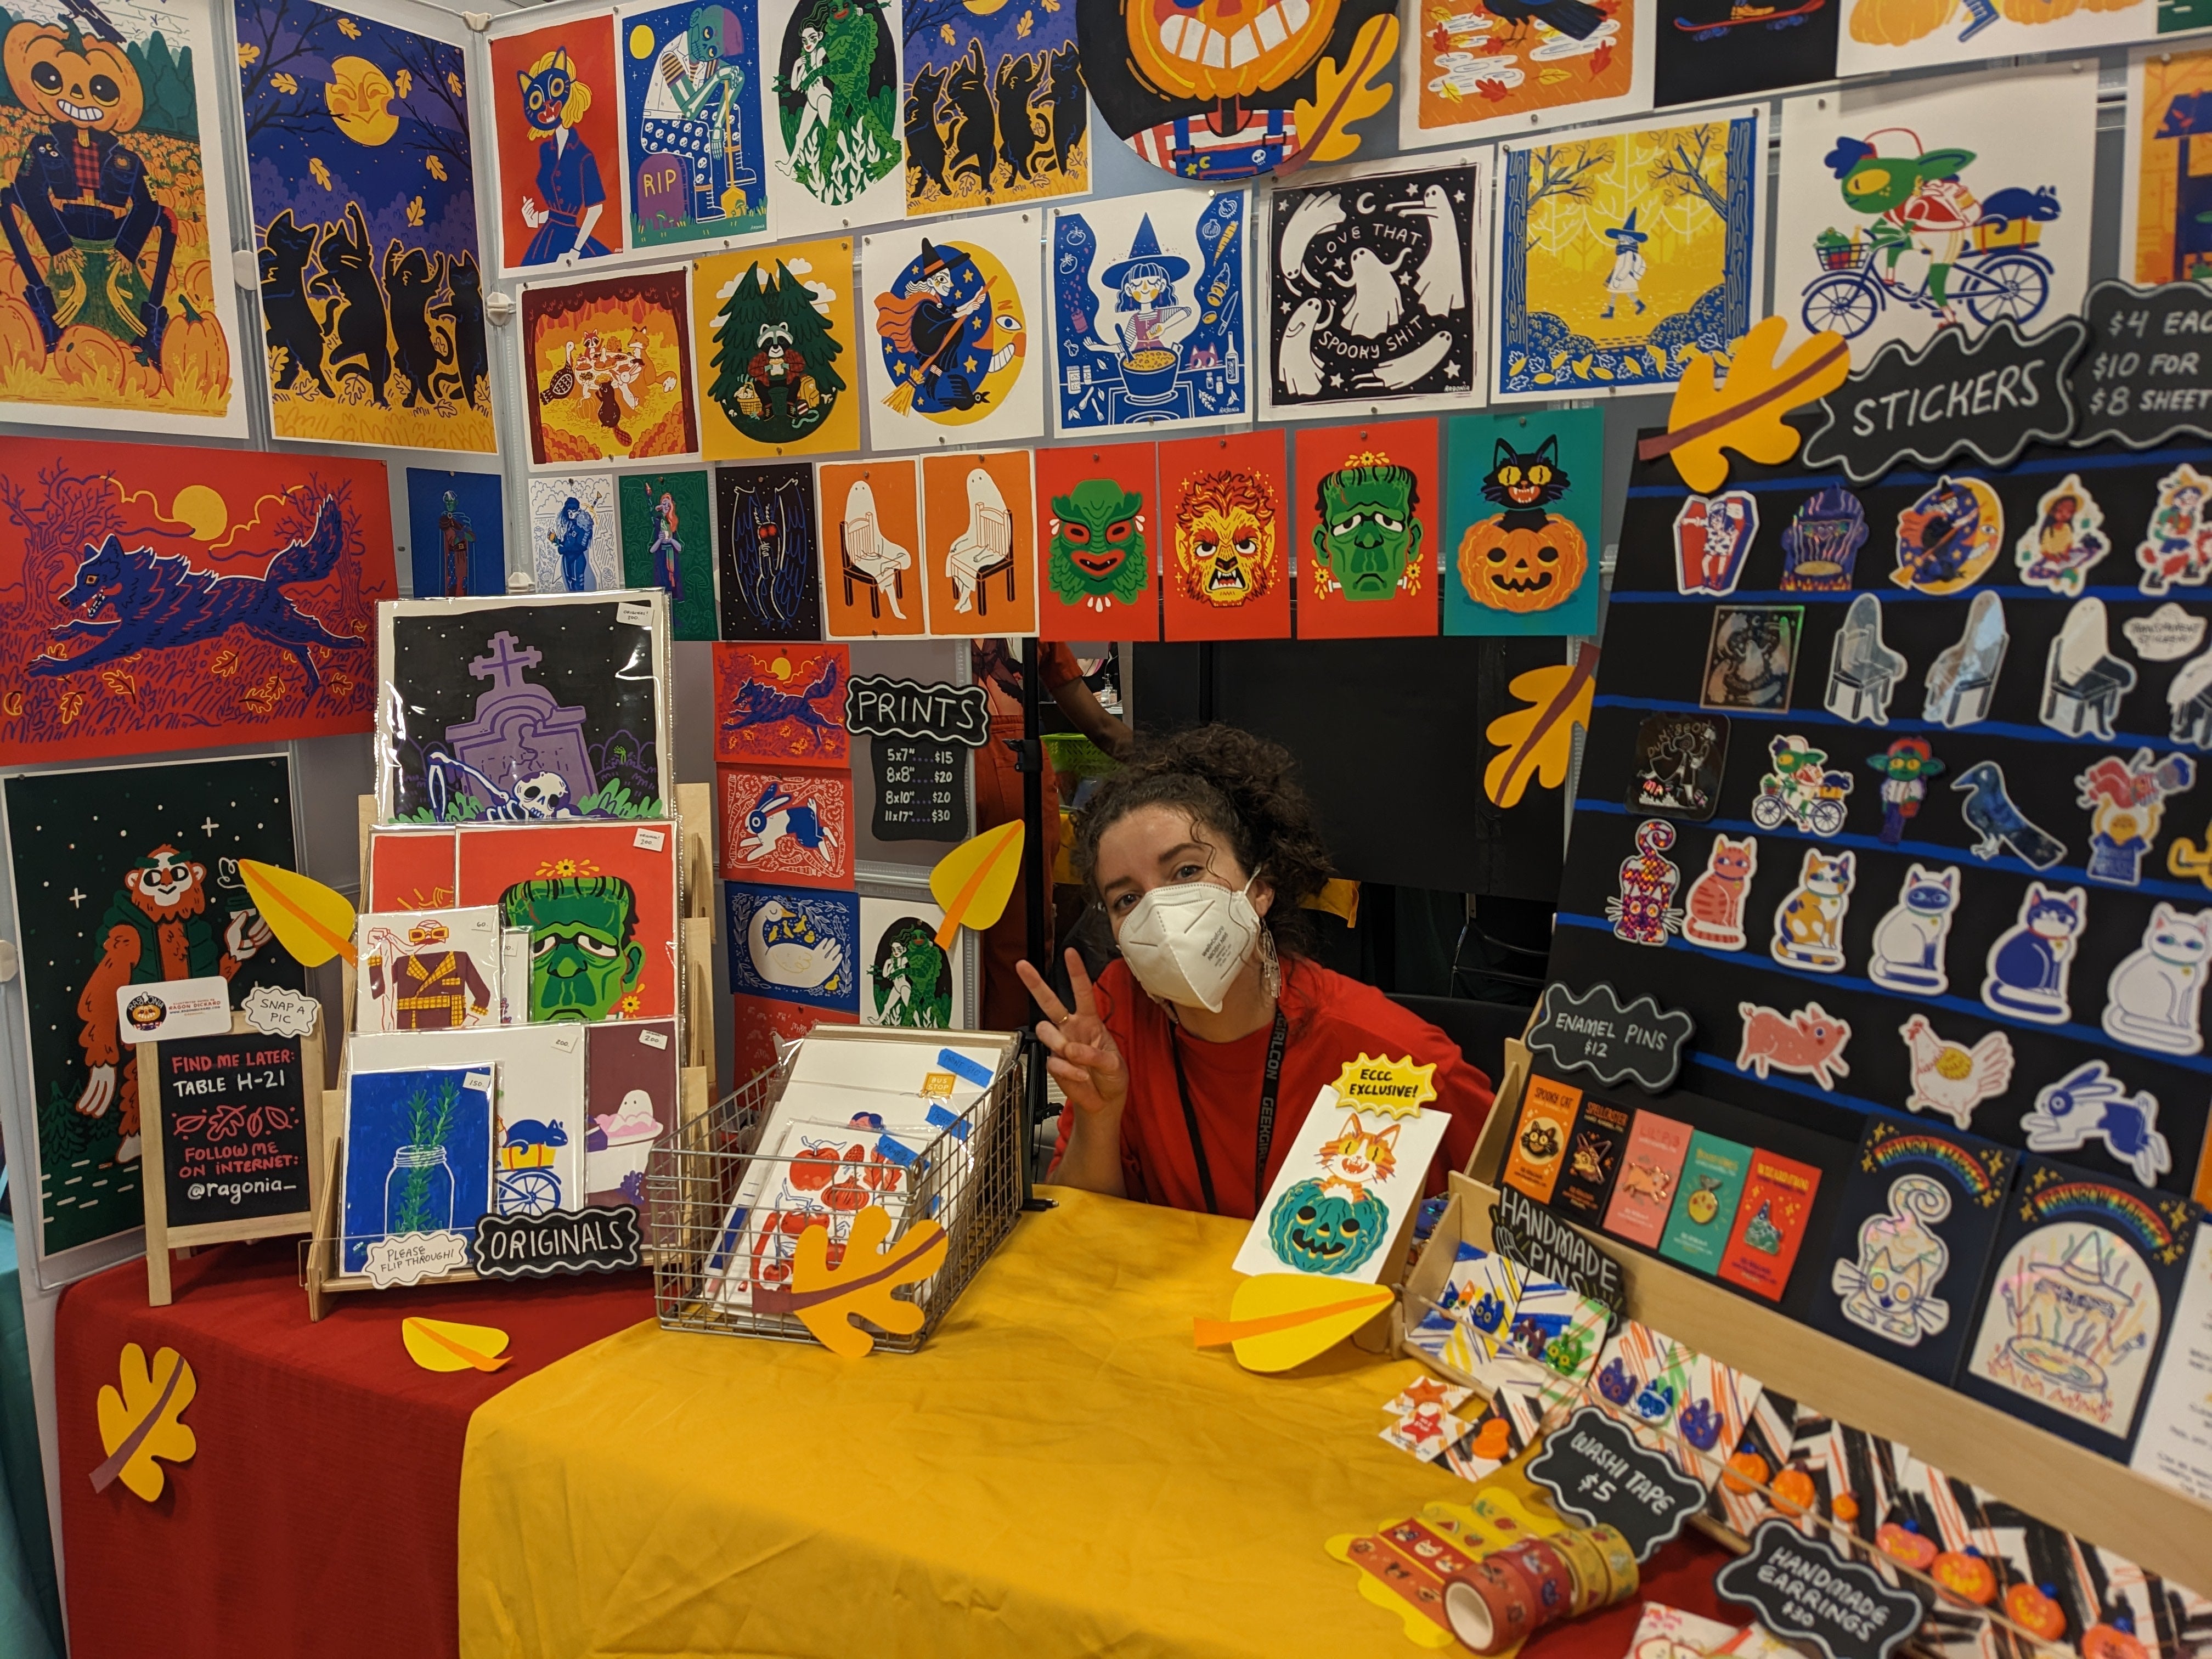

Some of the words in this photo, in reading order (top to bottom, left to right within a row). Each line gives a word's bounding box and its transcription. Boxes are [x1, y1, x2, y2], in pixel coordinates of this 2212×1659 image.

[644, 168, 676, 198] RIP
[1314, 225, 1361, 265] LOVE
[1372, 223, 1422, 246] THAT
[2109, 310, 2149, 338] $4
[1318, 330, 1380, 359] SPOOKY
[2092, 351, 2139, 382] $10
[2148, 352, 2200, 376] FOR
[1852, 359, 2045, 437] STICKERS
[2089, 386, 2131, 417] $8
[858, 691, 974, 729] PRINTS
[935, 751, 954, 764] $15
[934, 771, 953, 783] $20
[933, 791, 951, 804] $20
[932, 809, 950, 823] $30
[260, 998, 294, 1012] SNAP
[297, 1006, 305, 1014] A
[270, 1013, 291, 1024] PIC
[1555, 1012, 1616, 1039] ENAMEL
[1624, 1024, 1668, 1051] PINS
[172, 1056, 212, 1074] FIND
[217, 1054, 240, 1068] ME
[246, 1049, 295, 1066] LATER:
[1584, 1039, 1608, 1058] $12
[173, 1077, 227, 1097] TABLE
[237, 1069, 285, 1091] H-21
[1360, 1068, 1393, 1081] ECCC
[1349, 1084, 1419, 1098] EXCLUSIVE!
[185, 1143, 248, 1163] FOLLOW
[252, 1142, 279, 1156] ME
[179, 1164, 205, 1178] ON
[187, 1178, 297, 1205] @ragonia_
[491, 1221, 623, 1260] ORIGINALS
[1502, 1186, 1617, 1293] HANDMADE
[380, 1261, 403, 1272] FLIP
[404, 1249, 454, 1266] THROUGH!
[387, 1246, 426, 1262] PLEASE
[1530, 1241, 1584, 1294] PINS
[1570, 1431, 1630, 1480] WASHI
[1625, 1470, 1676, 1516] TAPE
[1577, 1472, 1617, 1502] $5
[1768, 1546, 1890, 1626] HANDMADE
[1757, 1565, 1876, 1643] EARRINGS
